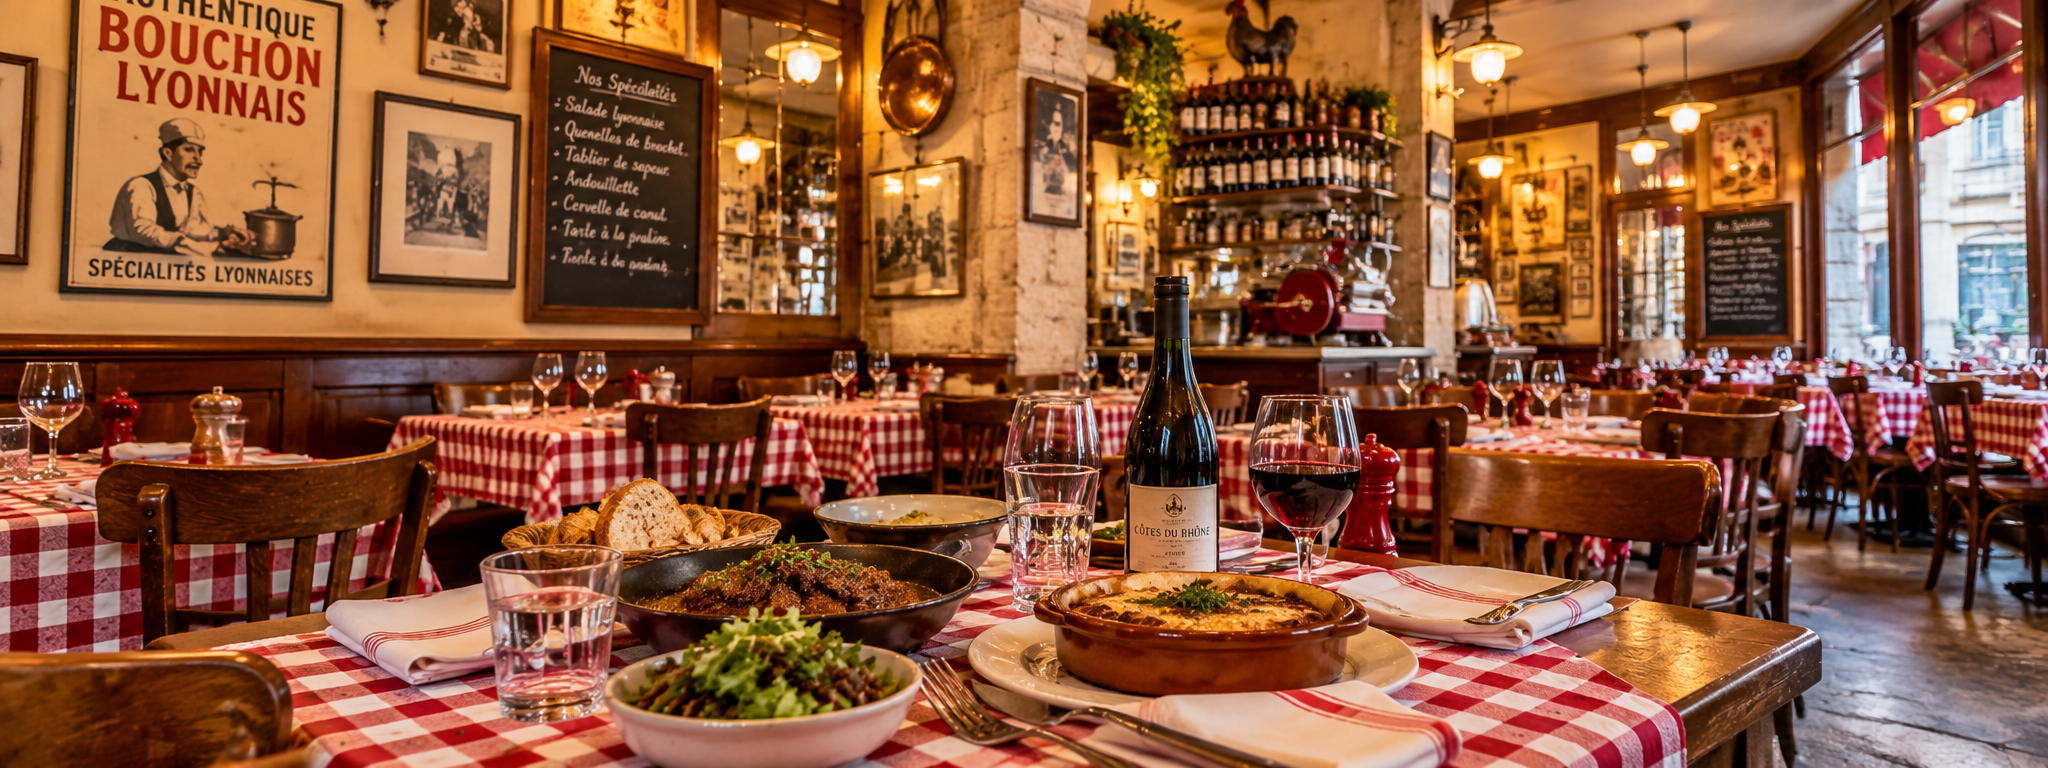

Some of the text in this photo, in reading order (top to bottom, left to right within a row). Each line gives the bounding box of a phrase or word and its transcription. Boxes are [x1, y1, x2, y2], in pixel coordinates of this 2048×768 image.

[112, 0, 315, 42] HENTIQUE
[99, 5, 322, 88] BOUCHON
[574, 65, 602, 87] Nos
[116, 60, 306, 126] LYONNAIS
[565, 95, 608, 119] Salade
[564, 120, 622, 145] Quenelles
[625, 132, 640, 148] de
[564, 145, 610, 166] Tablier
[613, 154, 628, 170] de
[563, 193, 612, 216] Cervelle
[615, 201, 630, 218] de
[88, 256, 314, 287] SPÉCIALITÉS LYONNAISES
[1164, 528, 1178, 538] DU
